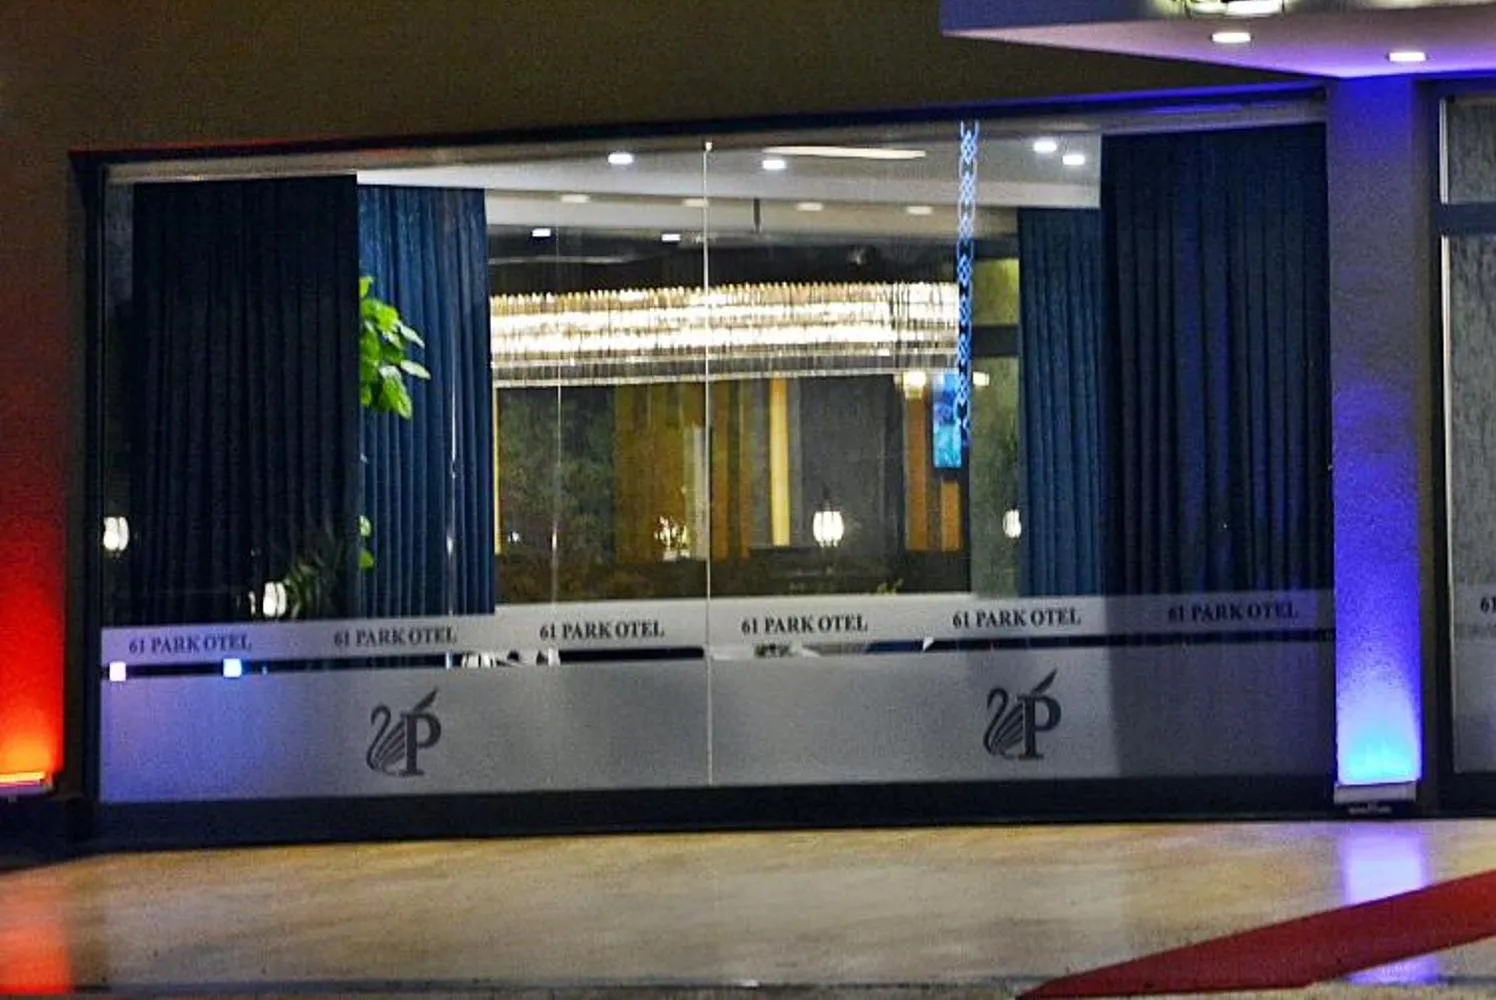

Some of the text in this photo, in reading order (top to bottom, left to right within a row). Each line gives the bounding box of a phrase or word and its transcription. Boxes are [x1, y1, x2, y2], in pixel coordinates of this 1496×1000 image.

[1191, 604, 1246, 622] PARK
[1247, 602, 1300, 620] OTEL
[1480, 595, 1496, 613] 61
[740, 613, 868, 635] 61 PARK OTEL
[952, 608, 1082, 629] 61 PARK OTEL
[334, 626, 457, 647] 61 PARK OTEL
[539, 620, 665, 640] 61 PARK OTEL
[128, 633, 253, 655] 61 PARK OTEL
